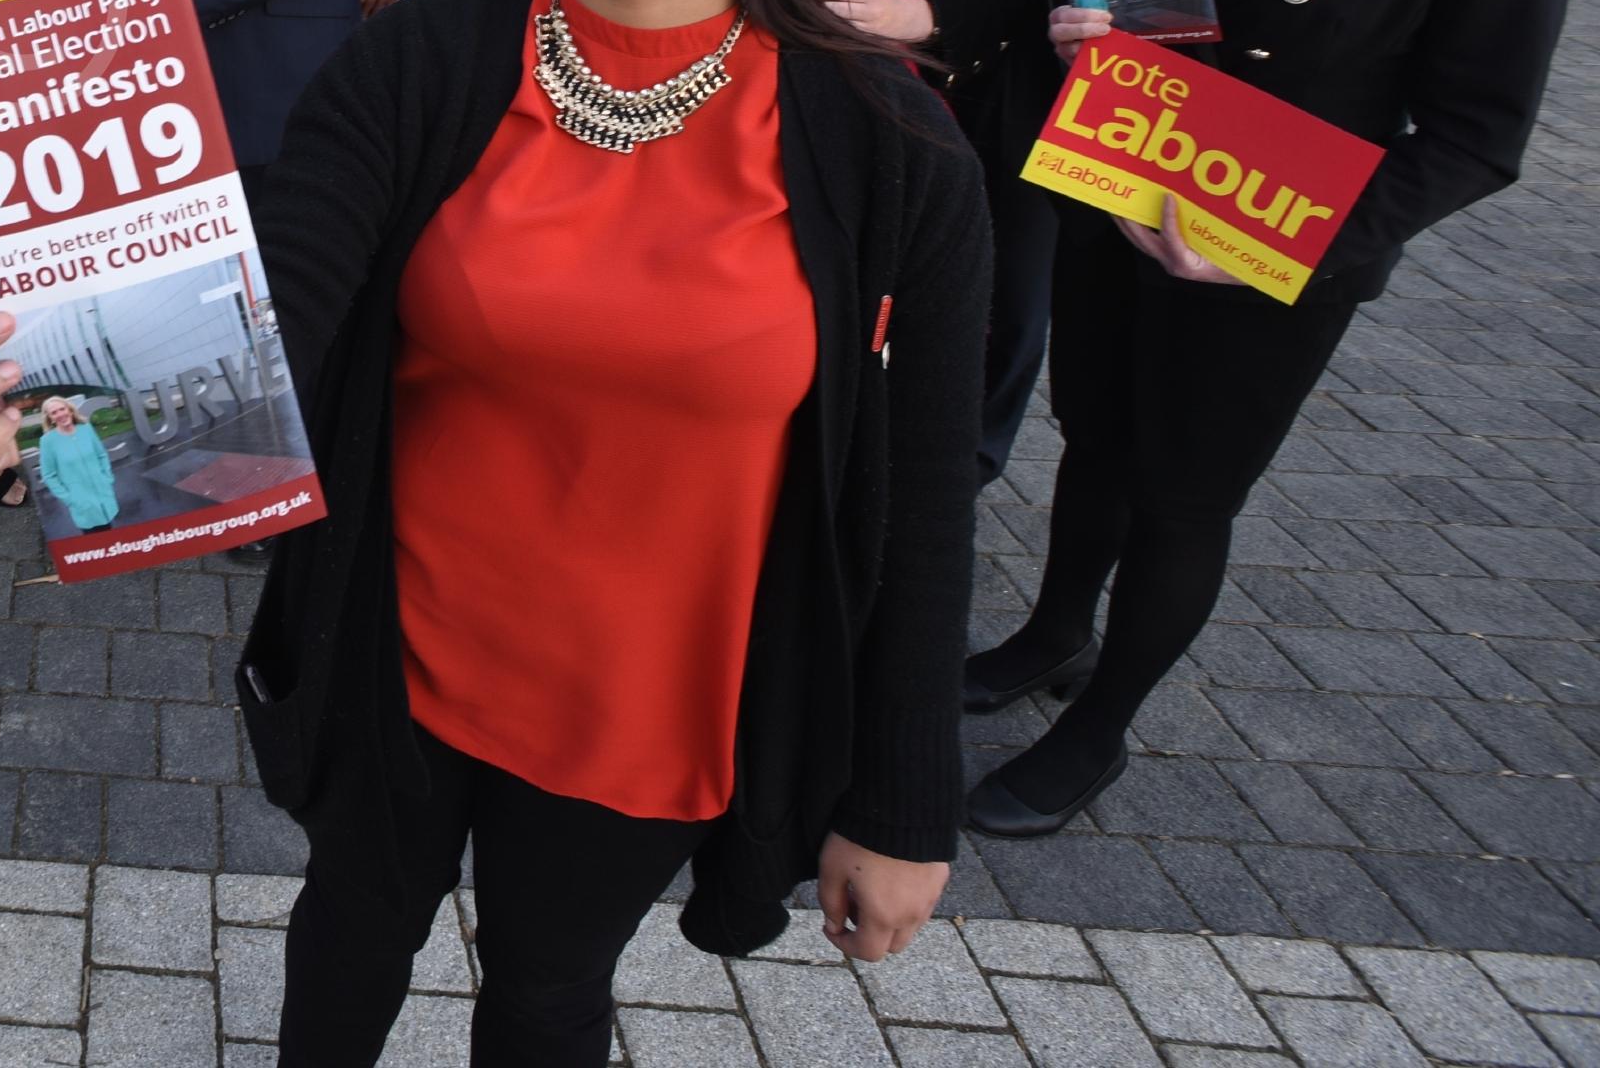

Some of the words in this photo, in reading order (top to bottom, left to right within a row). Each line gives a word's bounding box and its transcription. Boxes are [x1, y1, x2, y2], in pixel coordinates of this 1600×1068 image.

[8, 0, 92, 38] Labour
[31, 11, 172, 69] Election
[1090, 47, 1190, 108] vote
[1054, 78, 1334, 239] Labour
[48, 227, 117, 257] better
[124, 212, 155, 235] off
[160, 198, 210, 226] with
[216, 194, 229, 209] a
[107, 215, 238, 269] COUNCIL
[1056, 158, 1138, 200] Labour
[1189, 218, 1294, 286] labour.org.uk
[63, 491, 313, 567] www.sloughlabourgroup.org.uk
